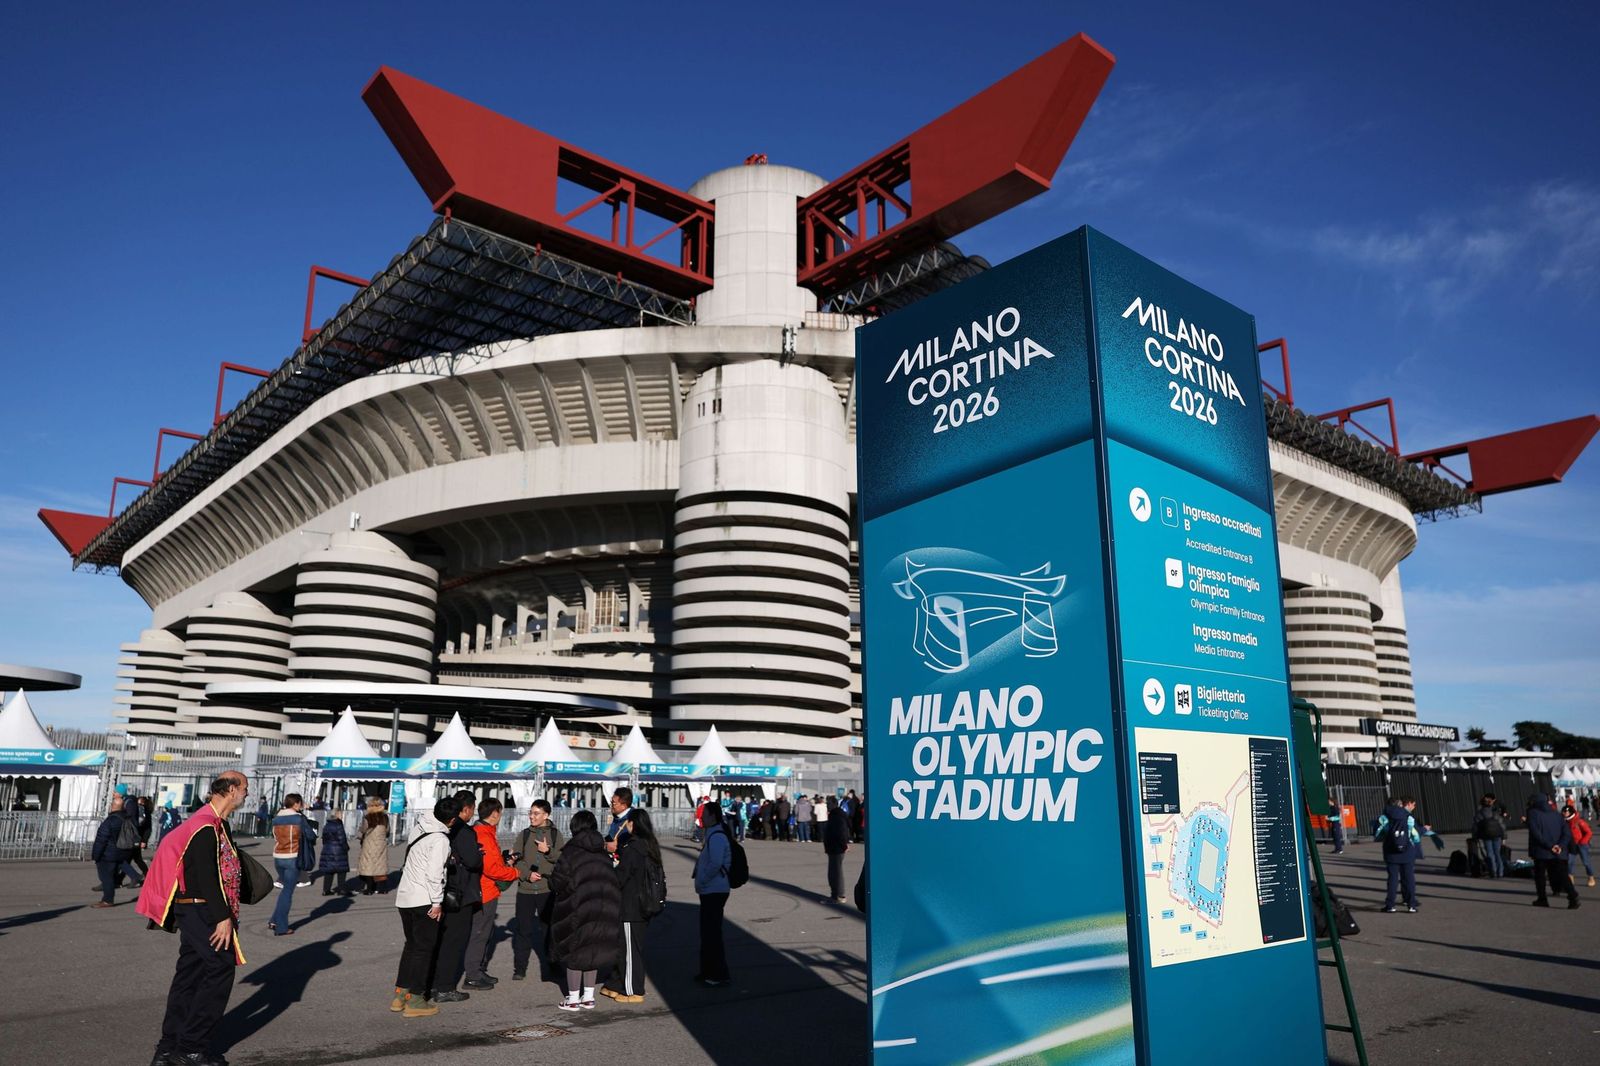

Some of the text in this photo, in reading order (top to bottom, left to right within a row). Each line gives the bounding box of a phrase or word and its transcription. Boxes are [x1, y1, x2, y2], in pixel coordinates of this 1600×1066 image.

[1121, 296, 1224, 362] MILANO
[886, 307, 1021, 383] MILANO
[908, 337, 1055, 406] CORTINA
[1144, 337, 1246, 408] CORTINA
[933, 387, 999, 434] 2026
[1168, 382, 1218, 425] 2026
[1167, 507, 1173, 517] B
[1183, 503, 1262, 538] Ingresso accreditati
[1184, 519, 1191, 531] B
[1186, 538, 1222, 556] Accredited
[1223, 545, 1248, 562] Entrance
[1188, 562, 1260, 592] Ingresso Famiglia
[1189, 579, 1230, 599] Olimpica
[1191, 599, 1265, 623] Olympic Family Entrance
[1193, 623, 1258, 646] Ingresso media
[1194, 643, 1245, 660] Media Entrance
[1197, 686, 1245, 705] Biglietteria
[889, 684, 1043, 735] MILANO
[1198, 706, 1248, 722] Ticketing Office
[1376, 720, 1455, 740] OFFICIAL MERCHANDISING
[45, 752, 55, 761] C
[389, 760, 398, 769] C
[912, 728, 1103, 777] OLYMPIC
[492, 762, 500, 770] C
[593, 764, 600, 772] C
[891, 778, 1078, 822] STADIUM
